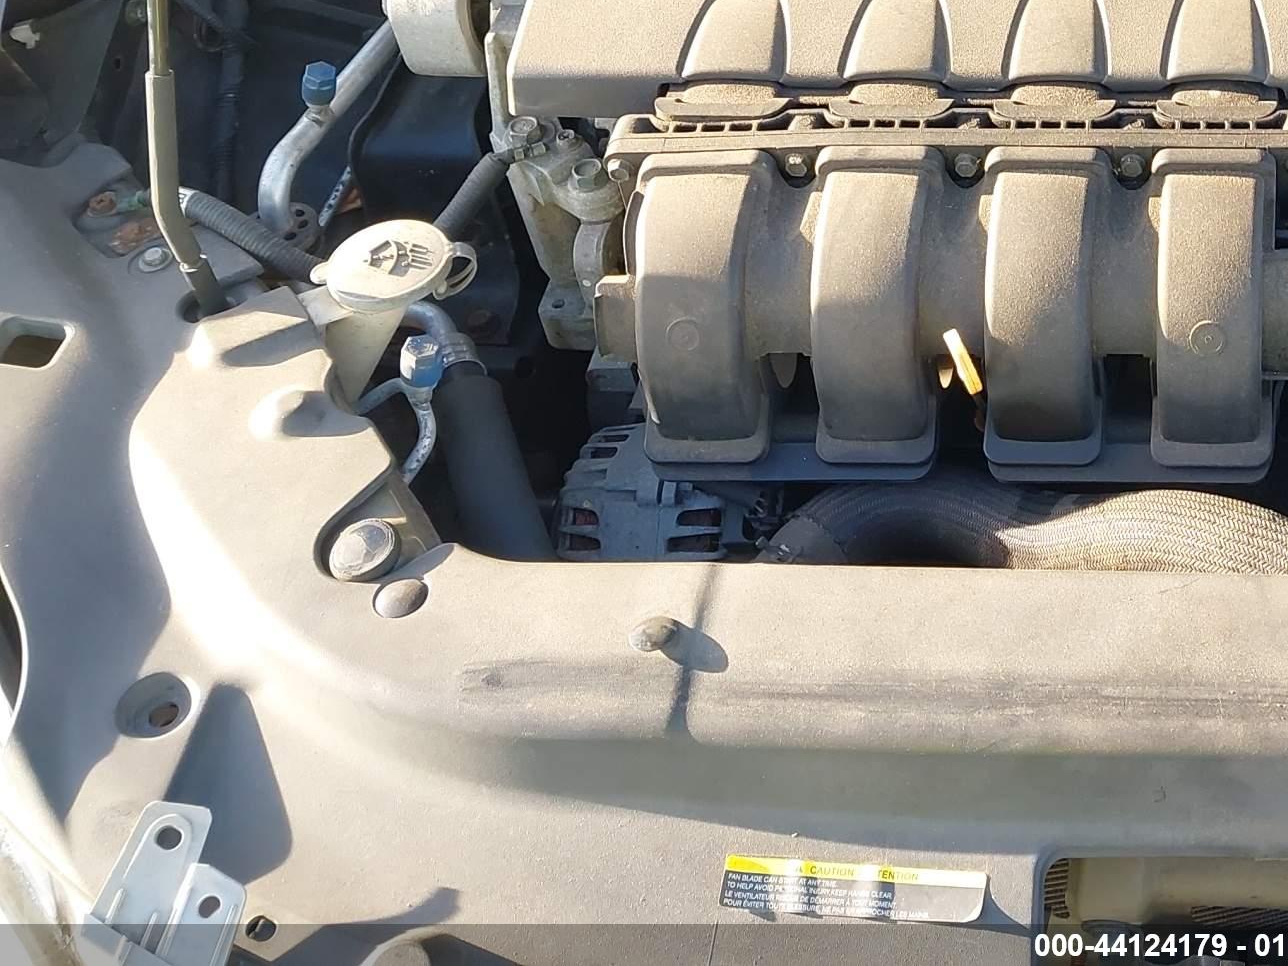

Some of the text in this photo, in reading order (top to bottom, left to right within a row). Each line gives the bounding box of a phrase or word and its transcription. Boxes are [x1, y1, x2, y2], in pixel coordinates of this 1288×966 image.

[810, 866, 854, 876] CAUTION
[728, 873, 740, 881] FAN
[742, 874, 762, 883] BLADE
[764, 875, 778, 884] CAN
[727, 881, 736, 889] TO
[737, 882, 753, 890] HELP
[754, 883, 774, 892] AVOID
[723, 898, 741, 907] POUR
[734, 891, 773, 901] VENTILATEUR
[800, 895, 809, 903] DE
